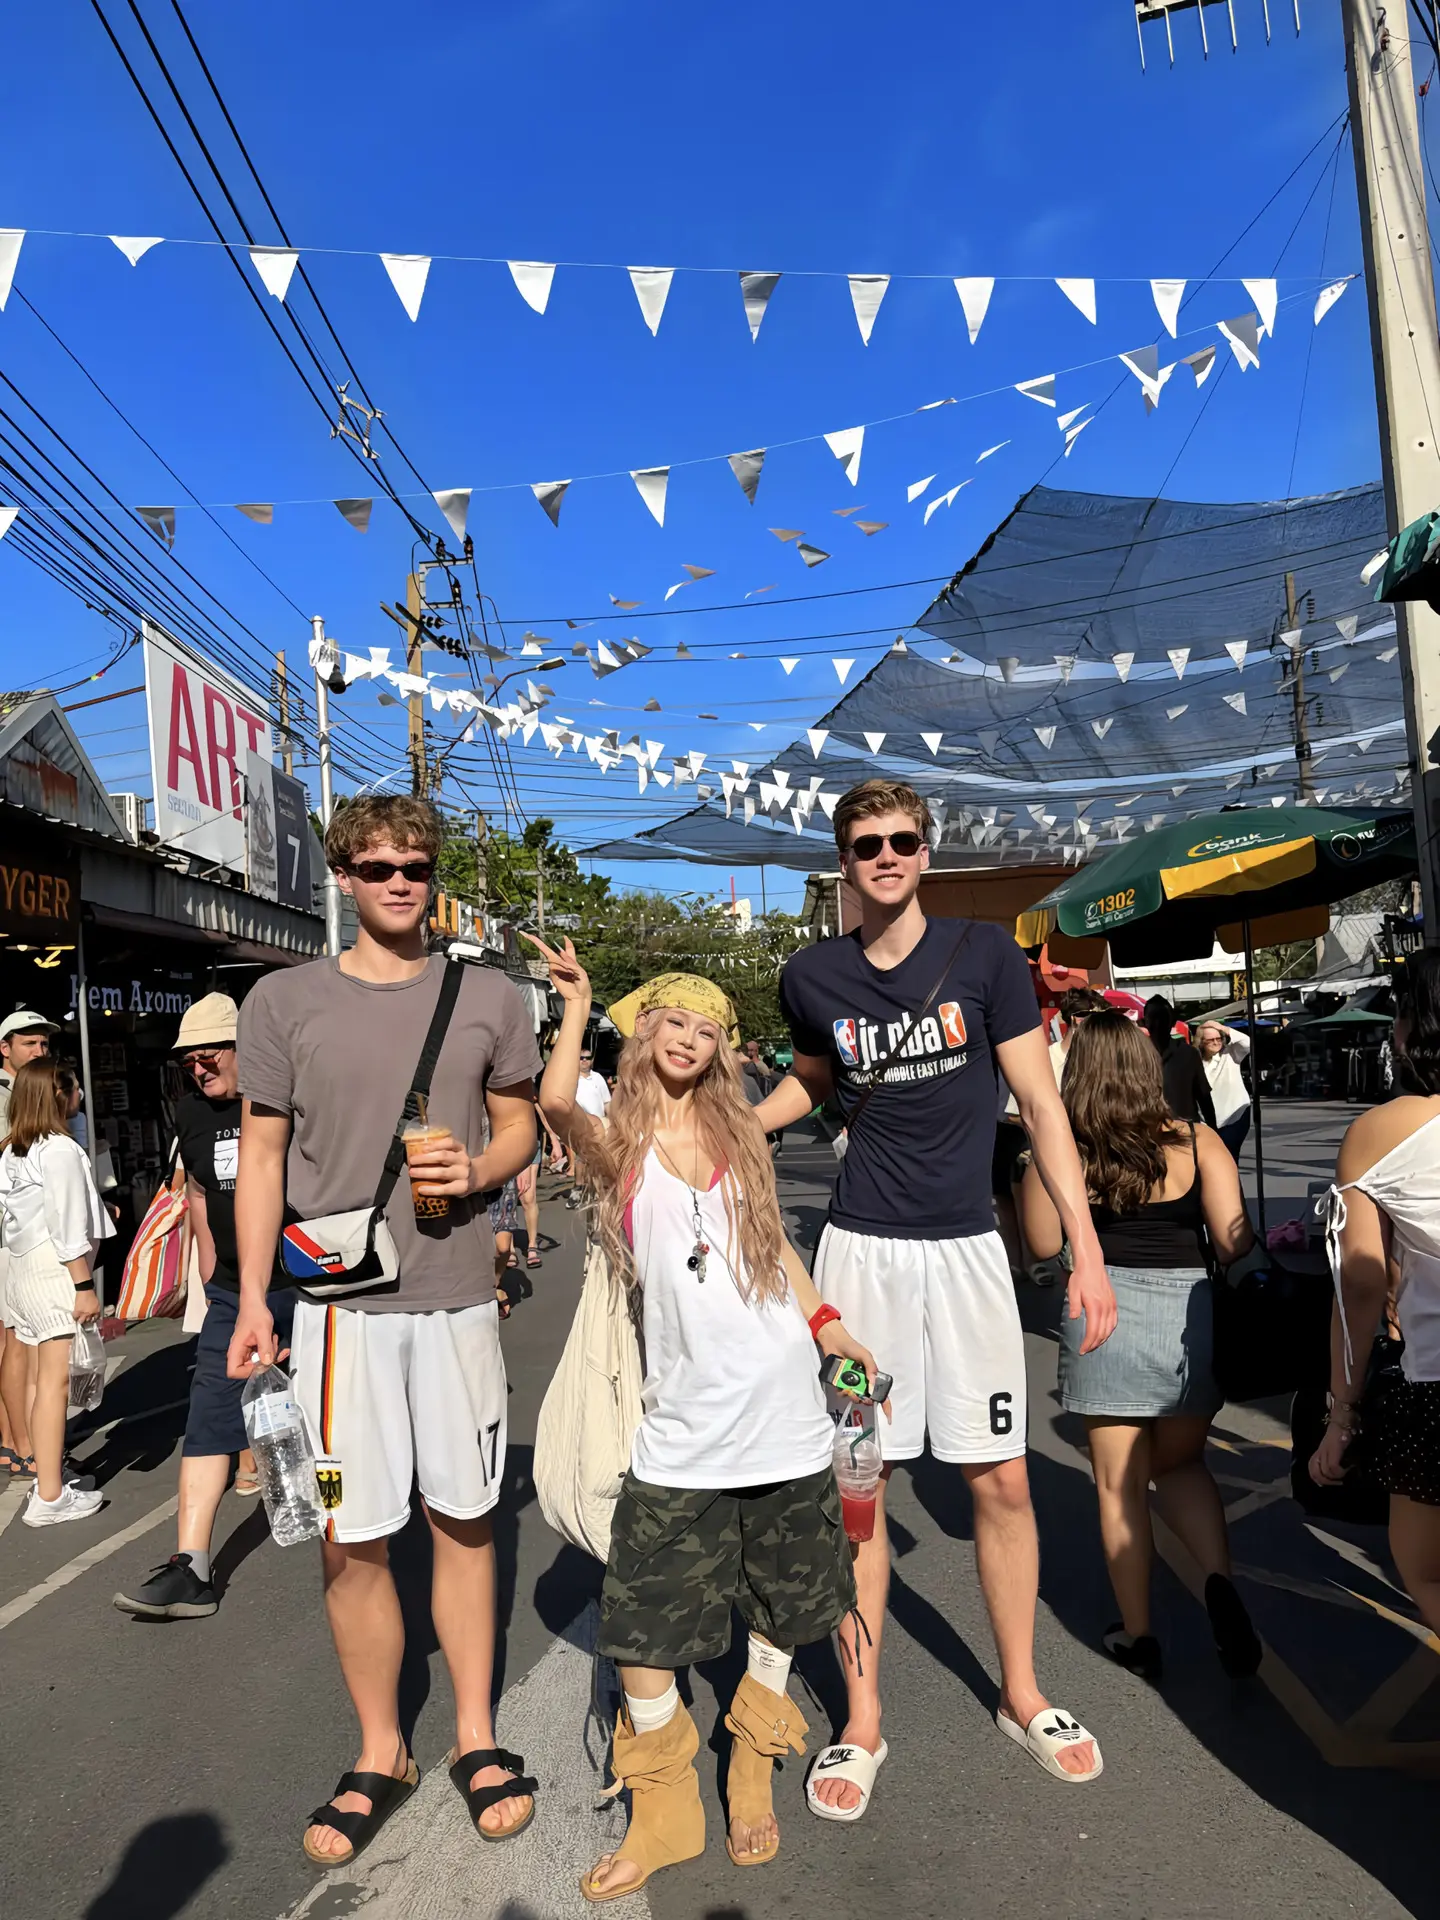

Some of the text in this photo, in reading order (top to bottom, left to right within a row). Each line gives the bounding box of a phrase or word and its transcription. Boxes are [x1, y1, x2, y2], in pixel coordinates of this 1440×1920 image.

[167, 662, 265, 822] ART
[287, 833, 301, 892] 7
[1096, 888, 1136, 915] 1302
[129, 980, 192, 1014] Aroma
[916, 1059, 939, 1079] EAST
[989, 1391, 1012, 1436] 6
[477, 1418, 501, 1487] 17
[825, 1748, 855, 1761] NIKE
